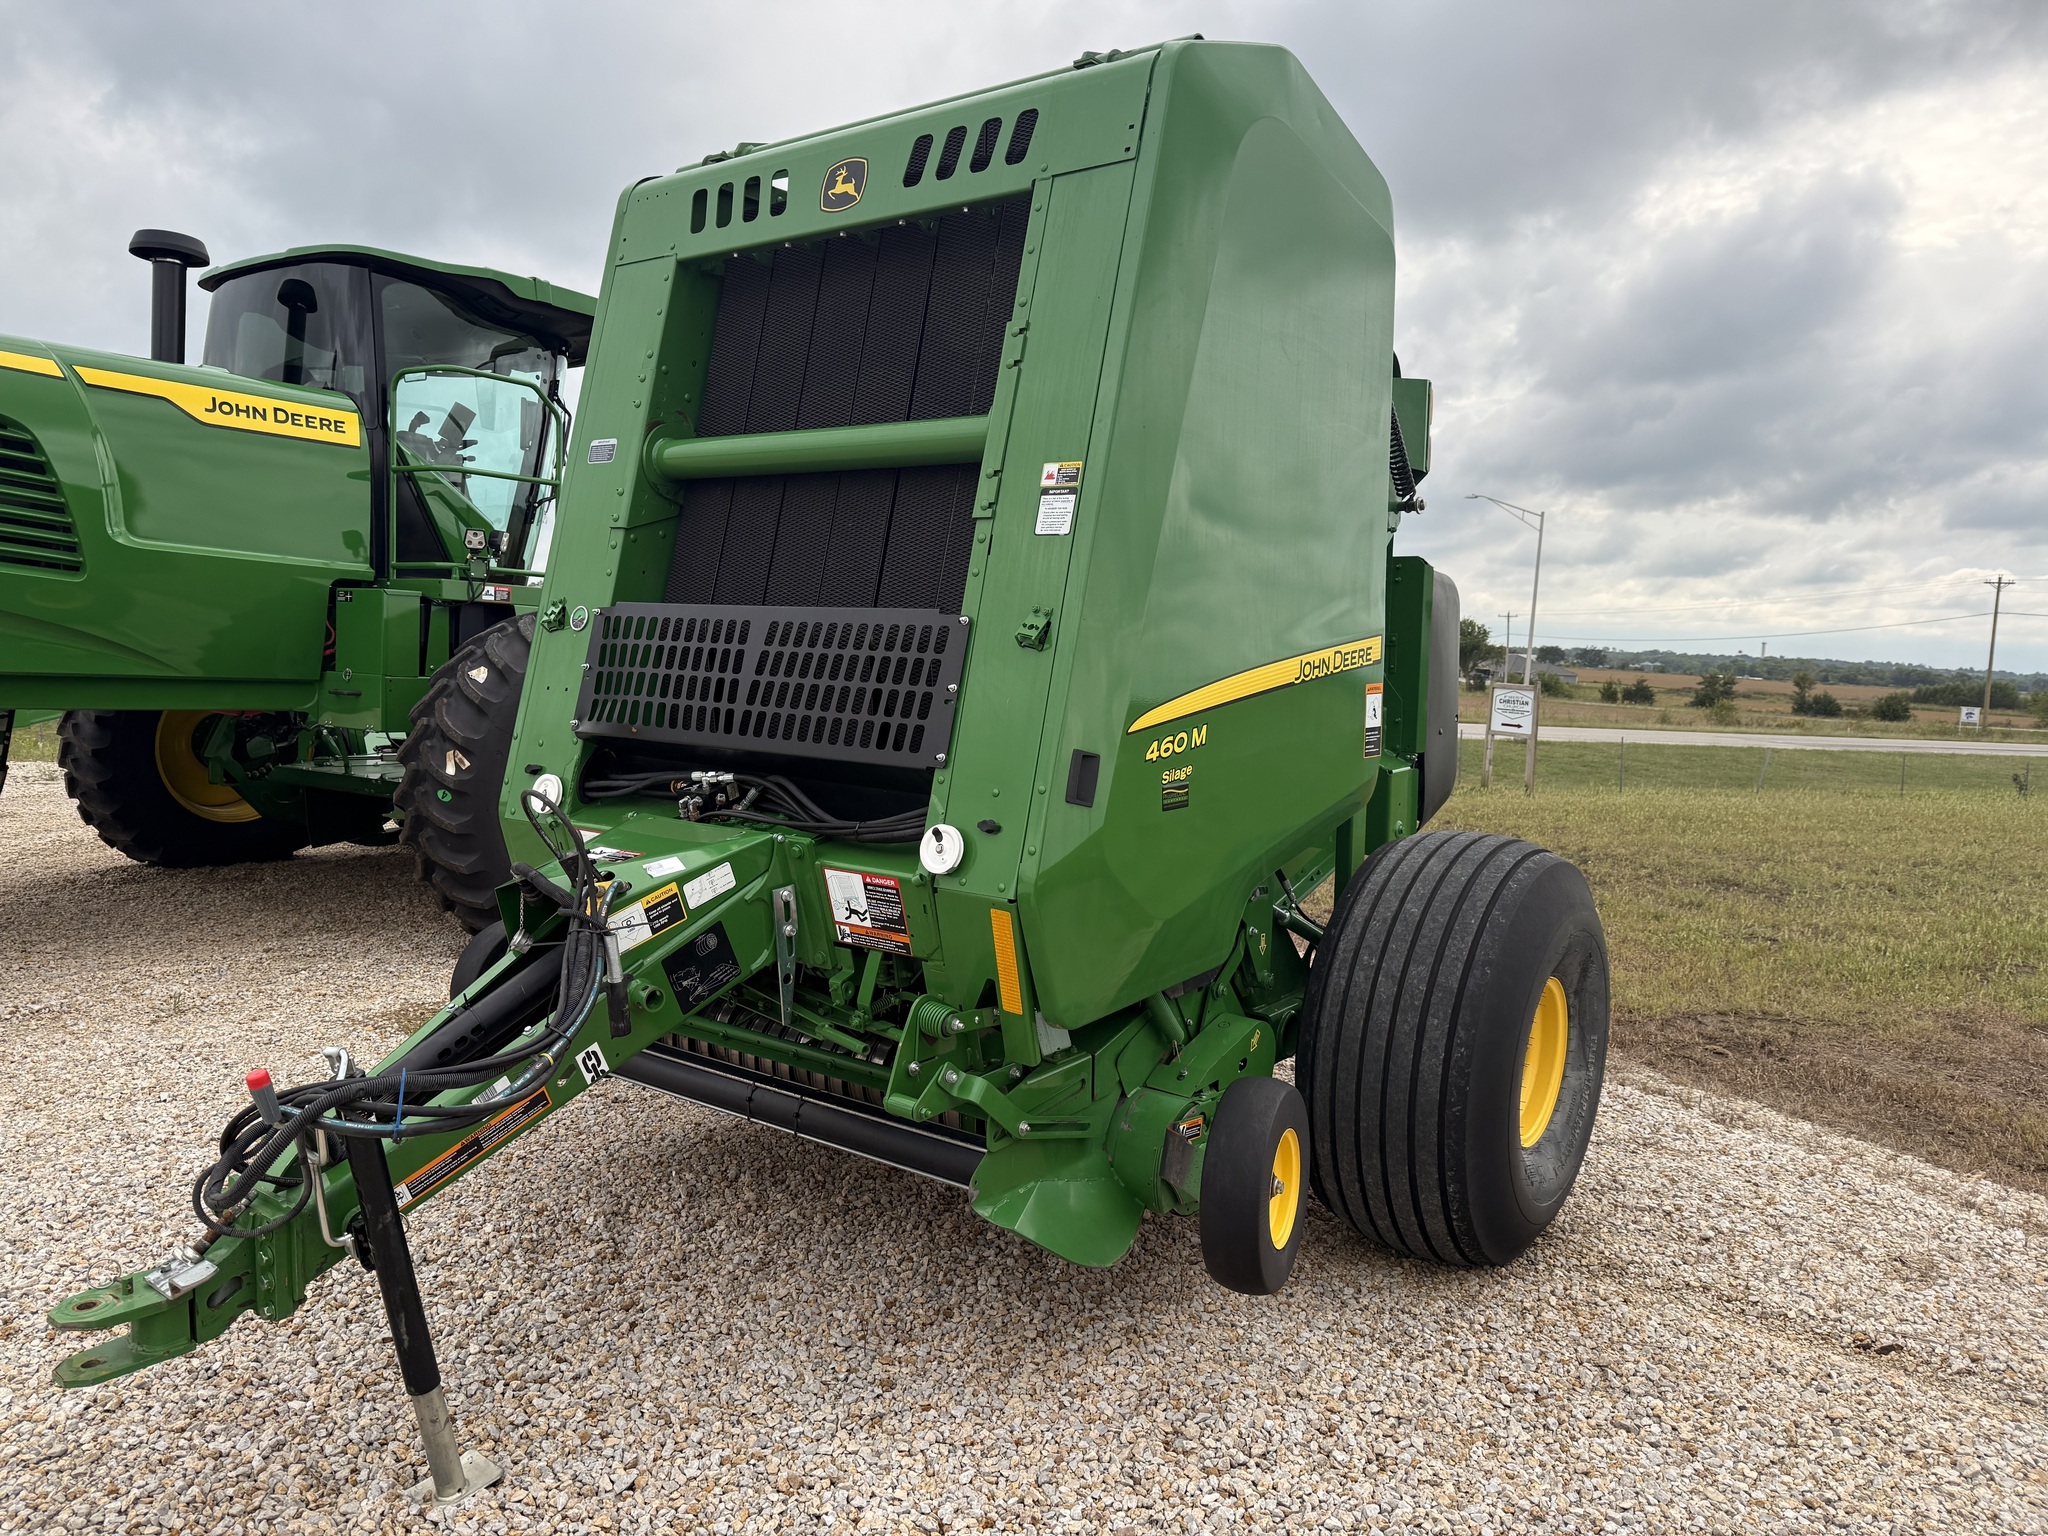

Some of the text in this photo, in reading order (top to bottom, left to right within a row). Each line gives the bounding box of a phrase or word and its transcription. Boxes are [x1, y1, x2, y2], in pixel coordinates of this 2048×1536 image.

[204, 396, 346, 434] JOHN DEERE
[1294, 646, 1373, 682] JOHN DEERE
[1498, 698, 1529, 706] CHRISTIAN
[1145, 723, 1208, 762] 460 M
[1161, 764, 1193, 785] Silage
[872, 877, 895, 886] DANGER
[650, 887, 674, 902] CAUTION
[464, 1122, 492, 1143] WARNING
